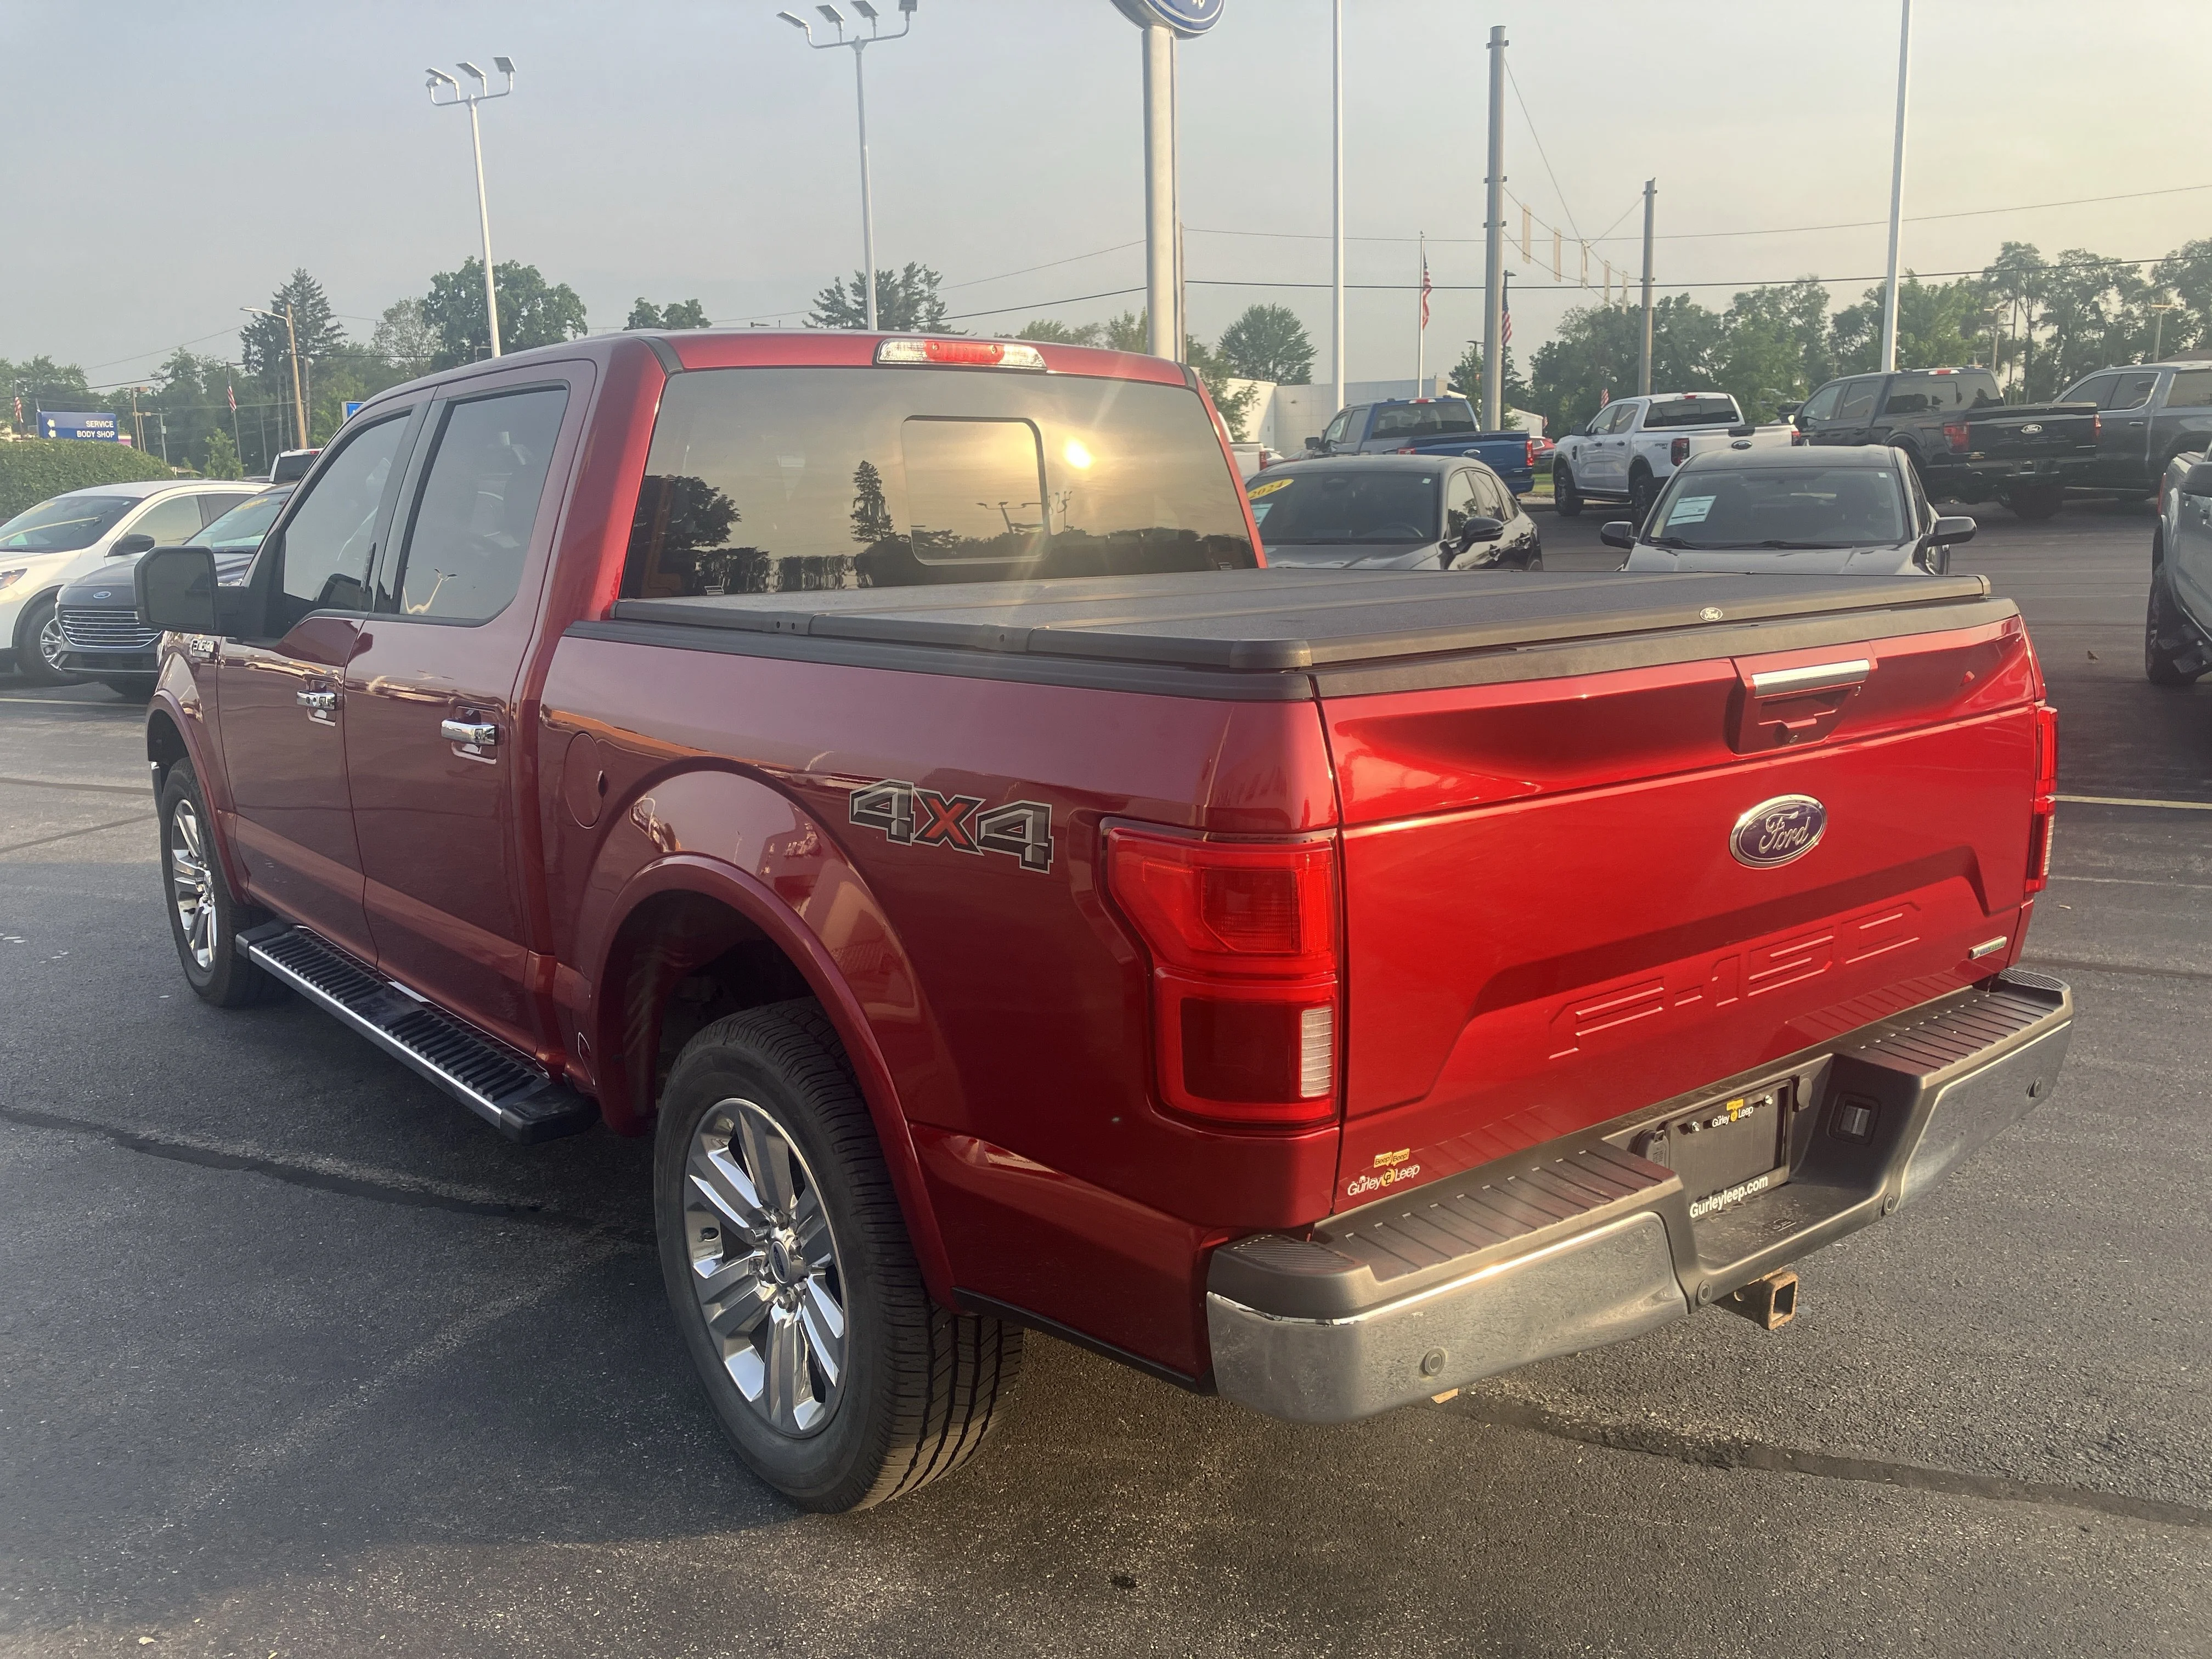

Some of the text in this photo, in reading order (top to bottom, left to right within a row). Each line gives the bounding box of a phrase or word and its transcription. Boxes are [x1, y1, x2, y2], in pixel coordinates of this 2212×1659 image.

[1758, 811, 1811, 854] Ford
[1549, 901, 1921, 1059] F-150
[1712, 1115, 1730, 1127] Gurley
[1738, 1106, 1754, 1119] Leep
[1375, 1152, 1409, 1165] Beep! Beep!
[1347, 1164, 1420, 1196] Gurley Leep
[1690, 1176, 1768, 1218] Gurleyleep.com
